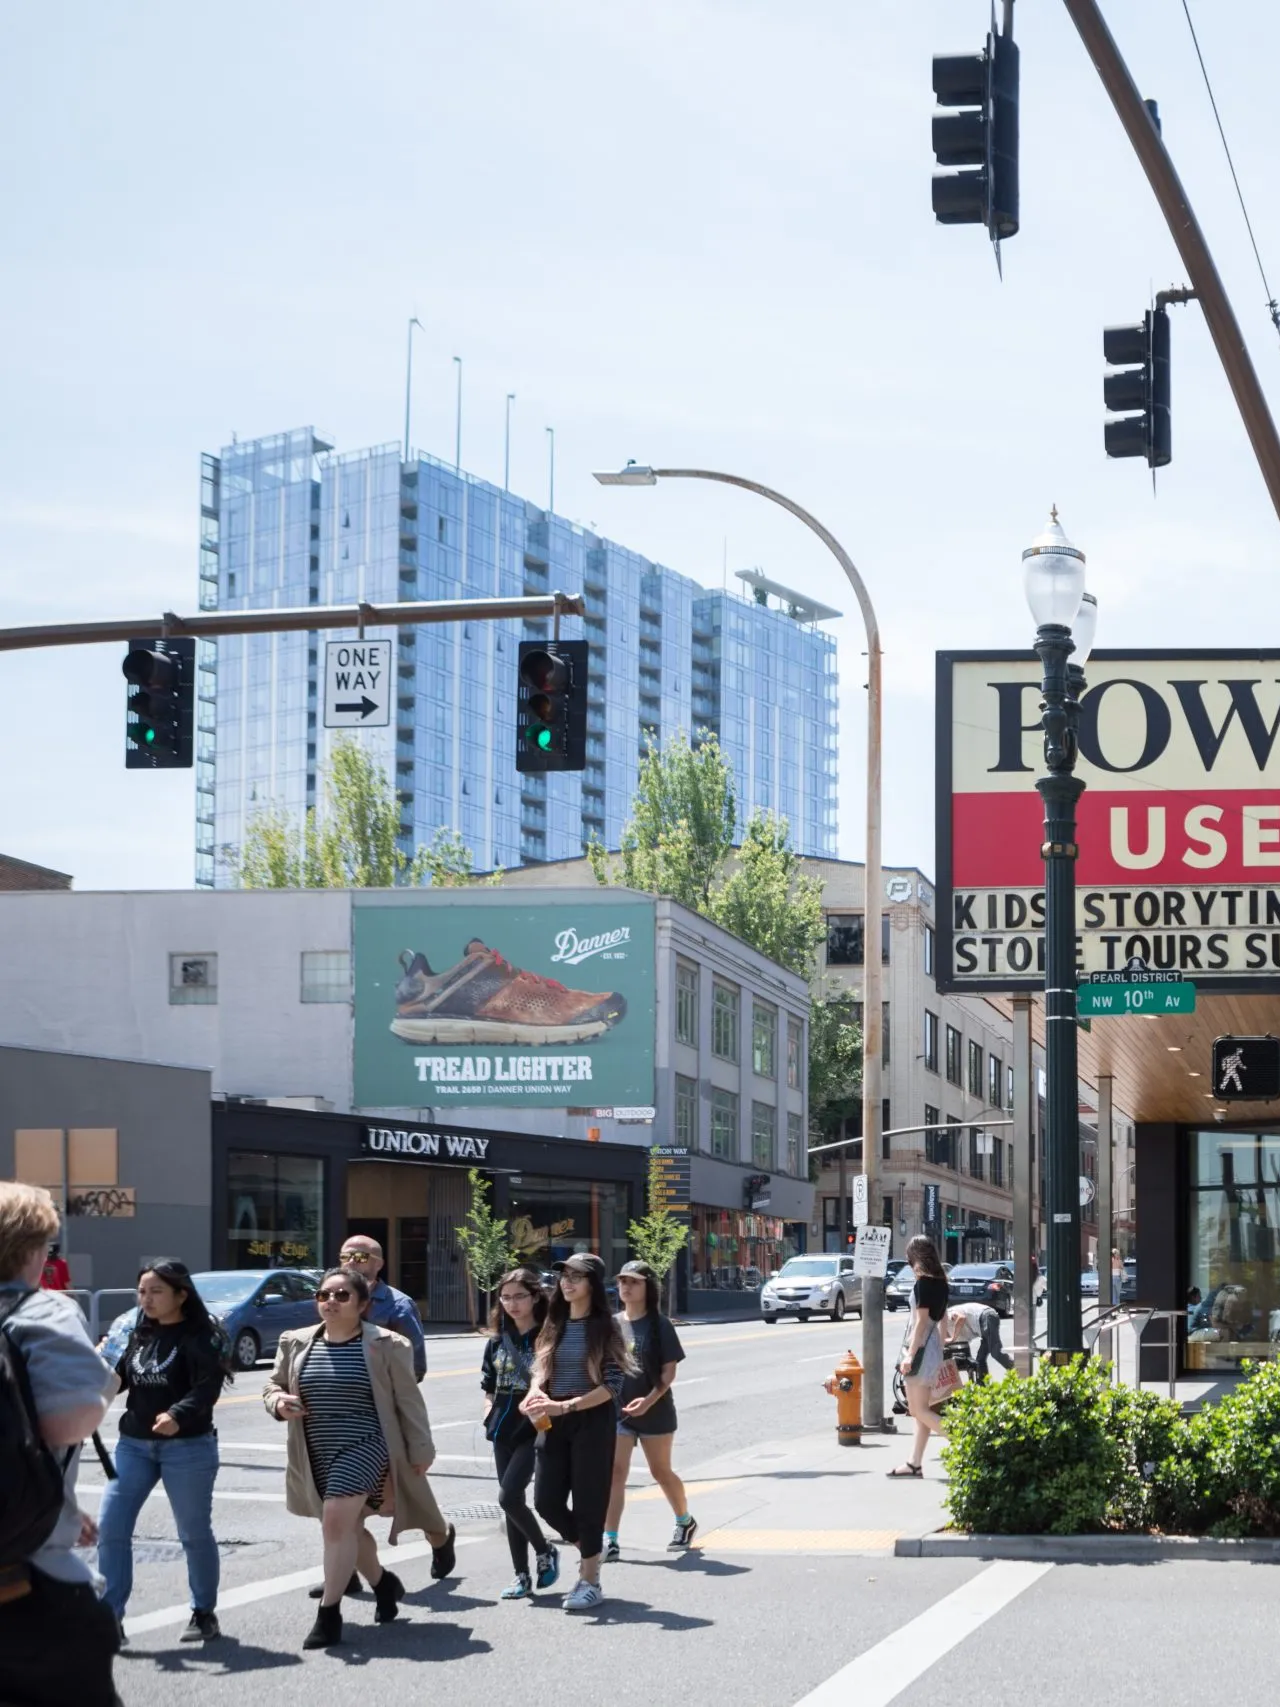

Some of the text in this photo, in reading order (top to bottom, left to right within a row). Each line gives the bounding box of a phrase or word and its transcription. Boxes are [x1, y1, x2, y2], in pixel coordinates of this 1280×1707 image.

[337, 647, 380, 667] ONE
[335, 670, 381, 691] WAY
[954, 892, 1046, 930] KIDS
[550, 927, 631, 962] Danner
[1100, 933, 1230, 970] TOURS
[1092, 972, 1180, 983] PEARL DISTRICT
[1092, 989, 1180, 1008] NW 10th Av
[413, 1055, 593, 1082] TREAD LIGHTER
[435, 1085, 460, 1094] TRAIL
[488, 1085, 523, 1094] DANNER
[525, 1084, 551, 1094] UNION
[552, 1084, 572, 1093] WAY
[596, 1109, 612, 1118] BIG
[367, 1127, 490, 1159] UNION WAY
[132, 1373, 169, 1386] PARIS
